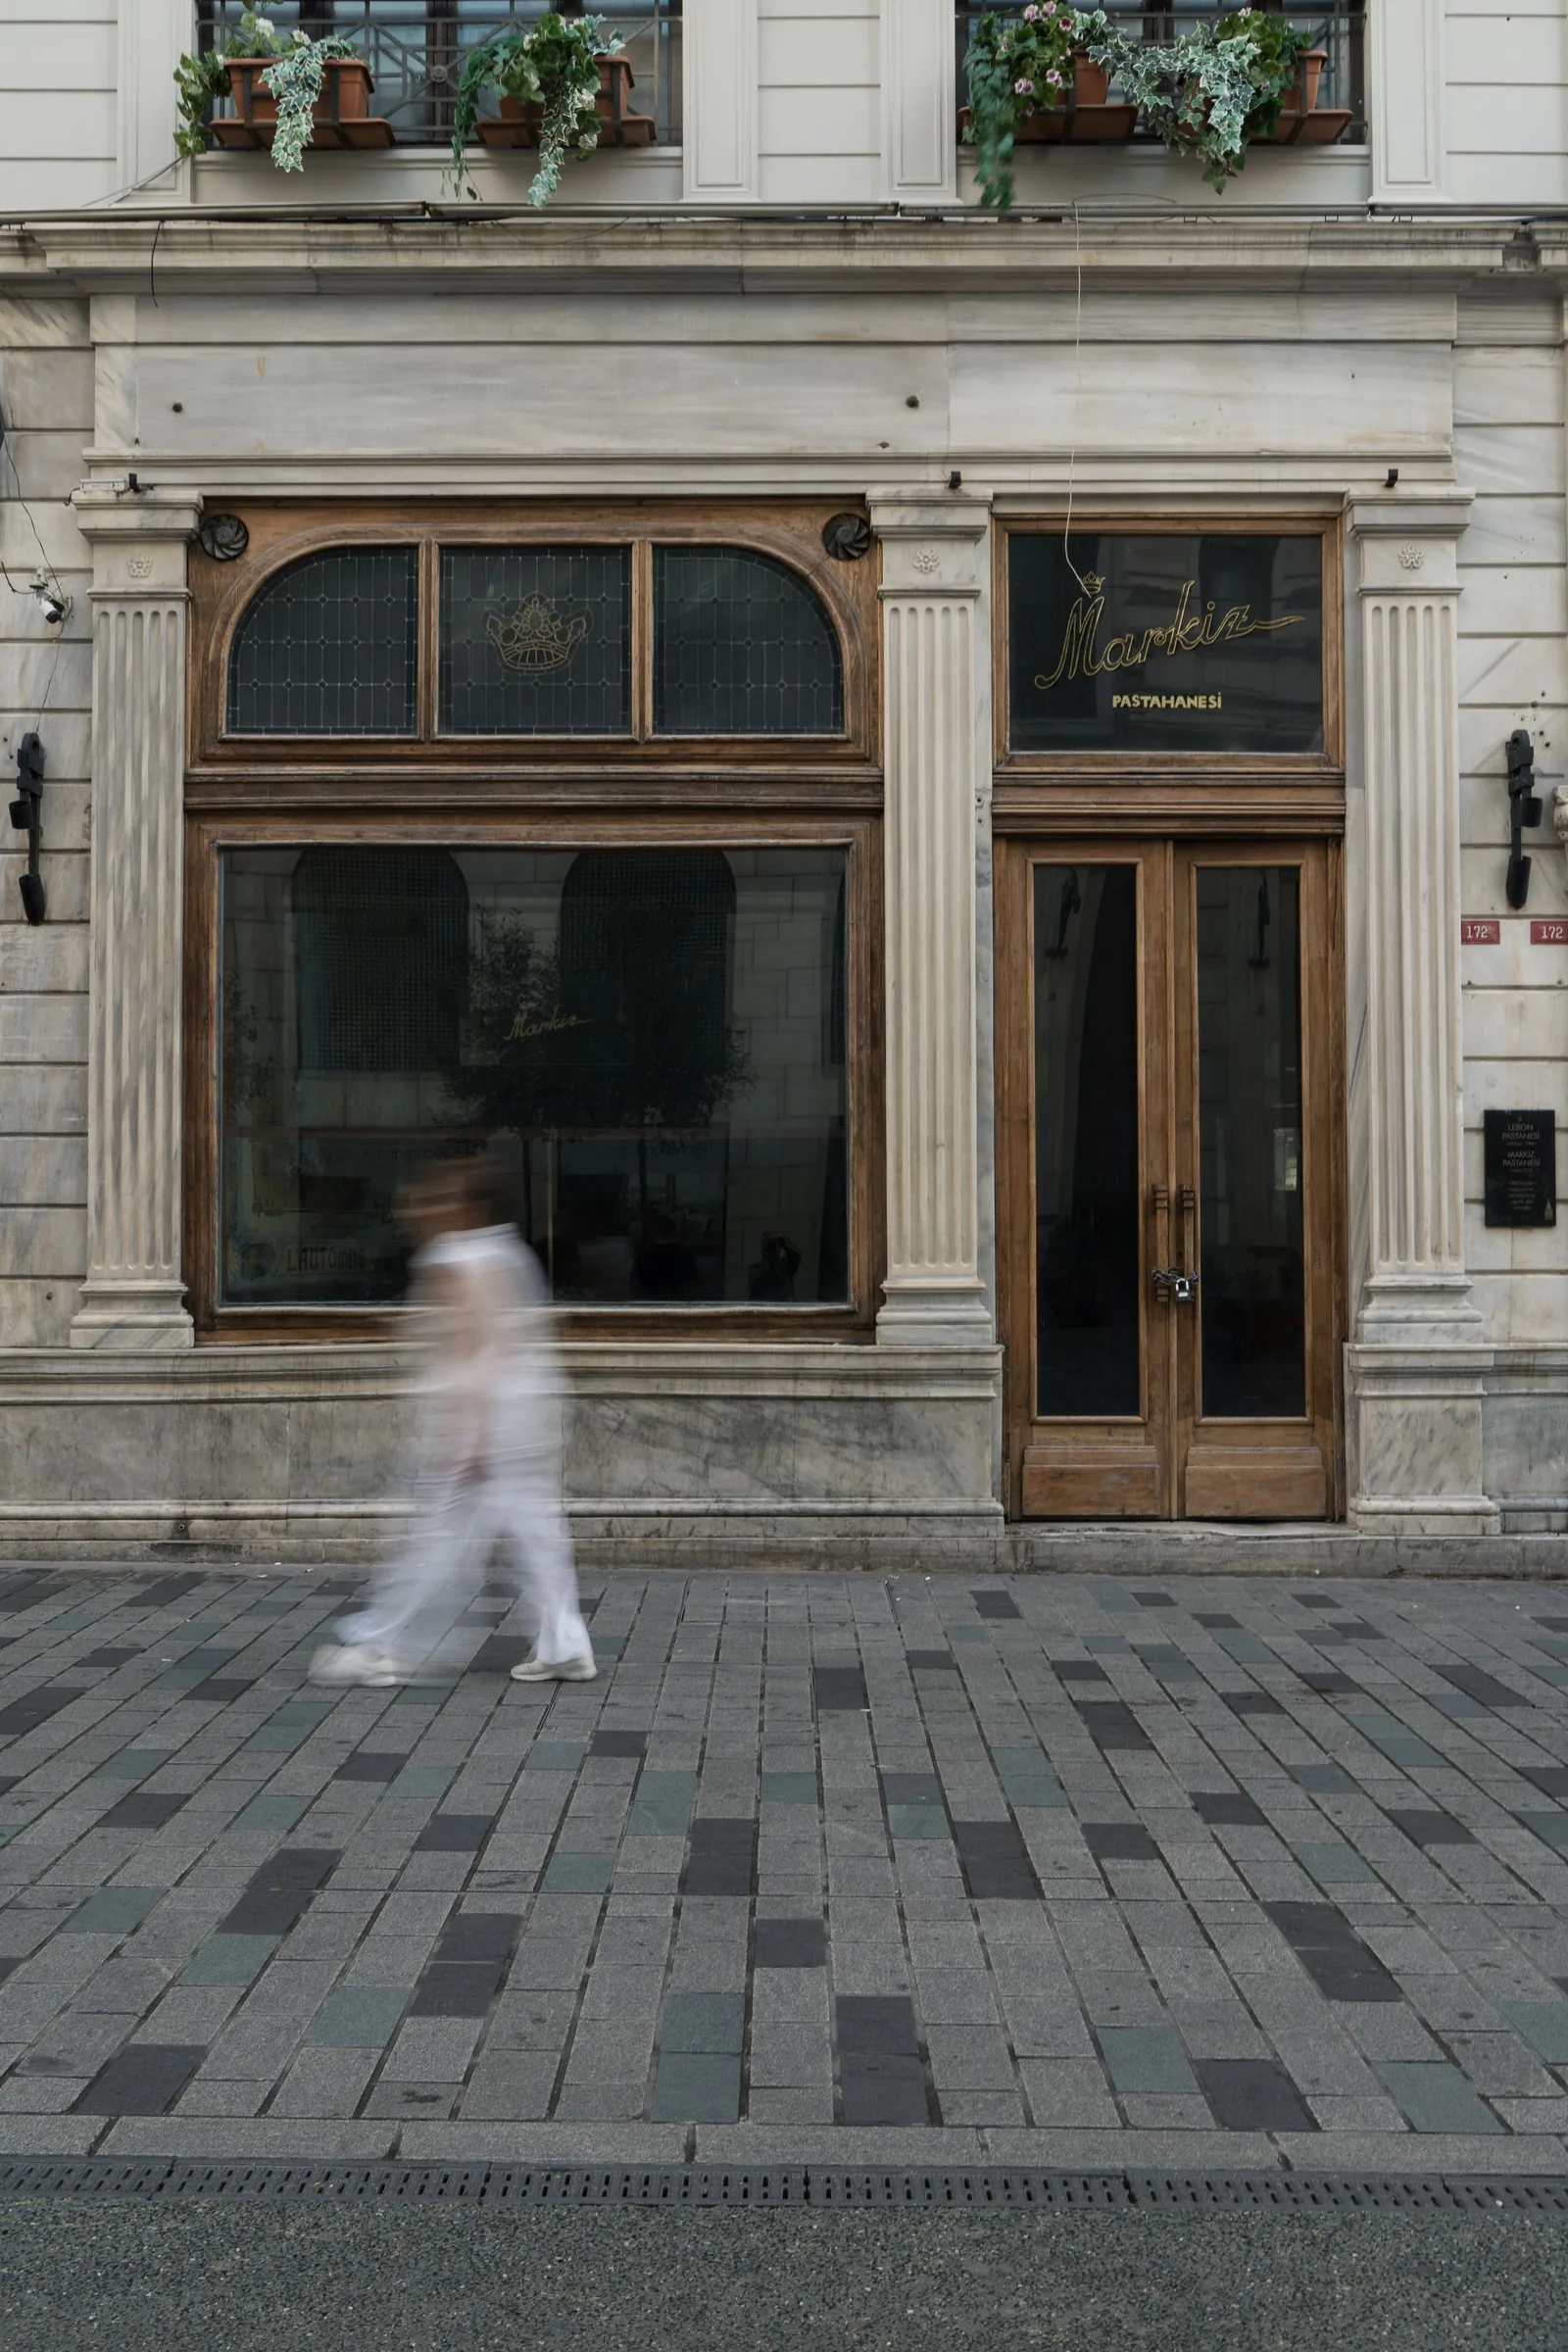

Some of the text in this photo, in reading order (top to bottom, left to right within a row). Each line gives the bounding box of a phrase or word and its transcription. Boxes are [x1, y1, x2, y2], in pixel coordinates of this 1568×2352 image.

[1034, 579, 1307, 690] Markiz
[1111, 691, 1222, 710] PASTAHANESİ
[1466, 925, 1488, 939] 172
[1542, 925, 1563, 939] 172
[502, 1004, 596, 1042] Markiz
[1501, 1130, 1540, 1140] PASTANESİ
[1502, 1157, 1541, 1166] PASTANESİ
